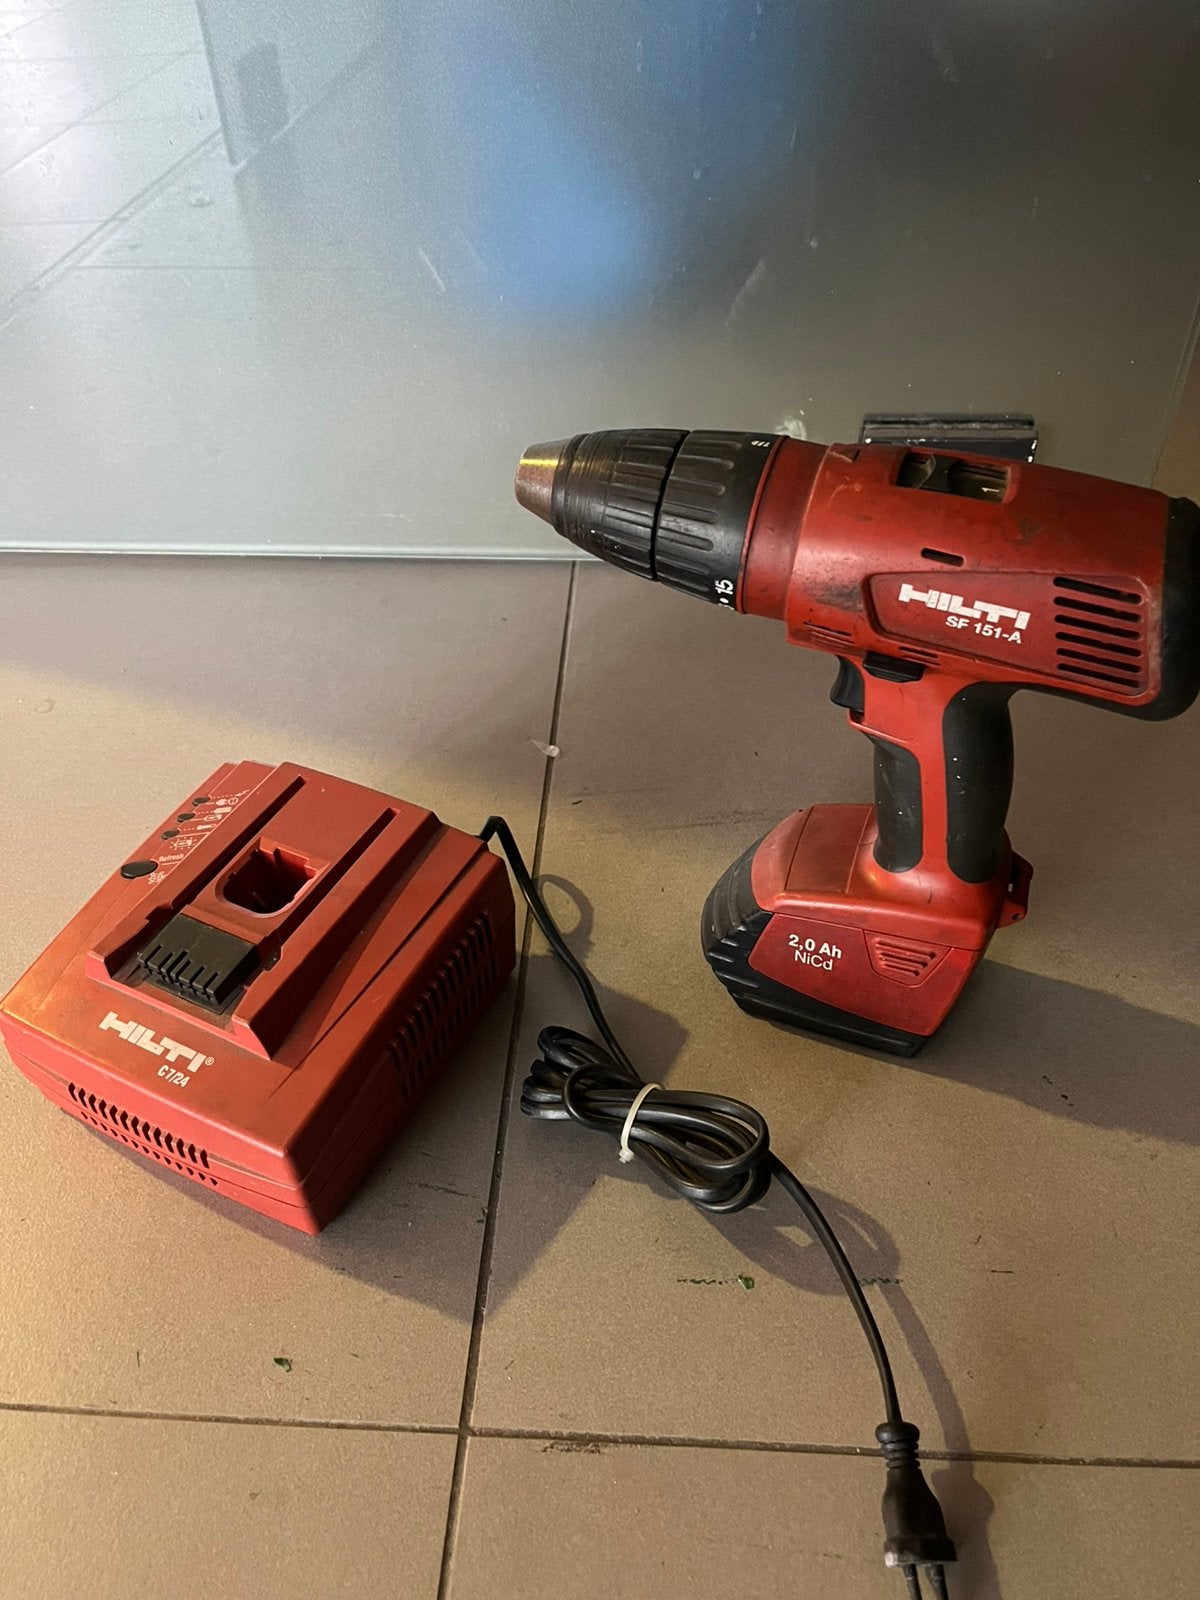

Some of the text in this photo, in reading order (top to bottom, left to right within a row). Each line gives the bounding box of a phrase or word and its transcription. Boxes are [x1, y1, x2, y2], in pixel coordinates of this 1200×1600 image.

[714, 578, 734, 595] 15
[897, 582, 1031, 630] HILTI
[945, 615, 1022, 645] SF 151-A
[788, 934, 842, 959] 2,0 Ah
[794, 949, 833, 971] NiCd
